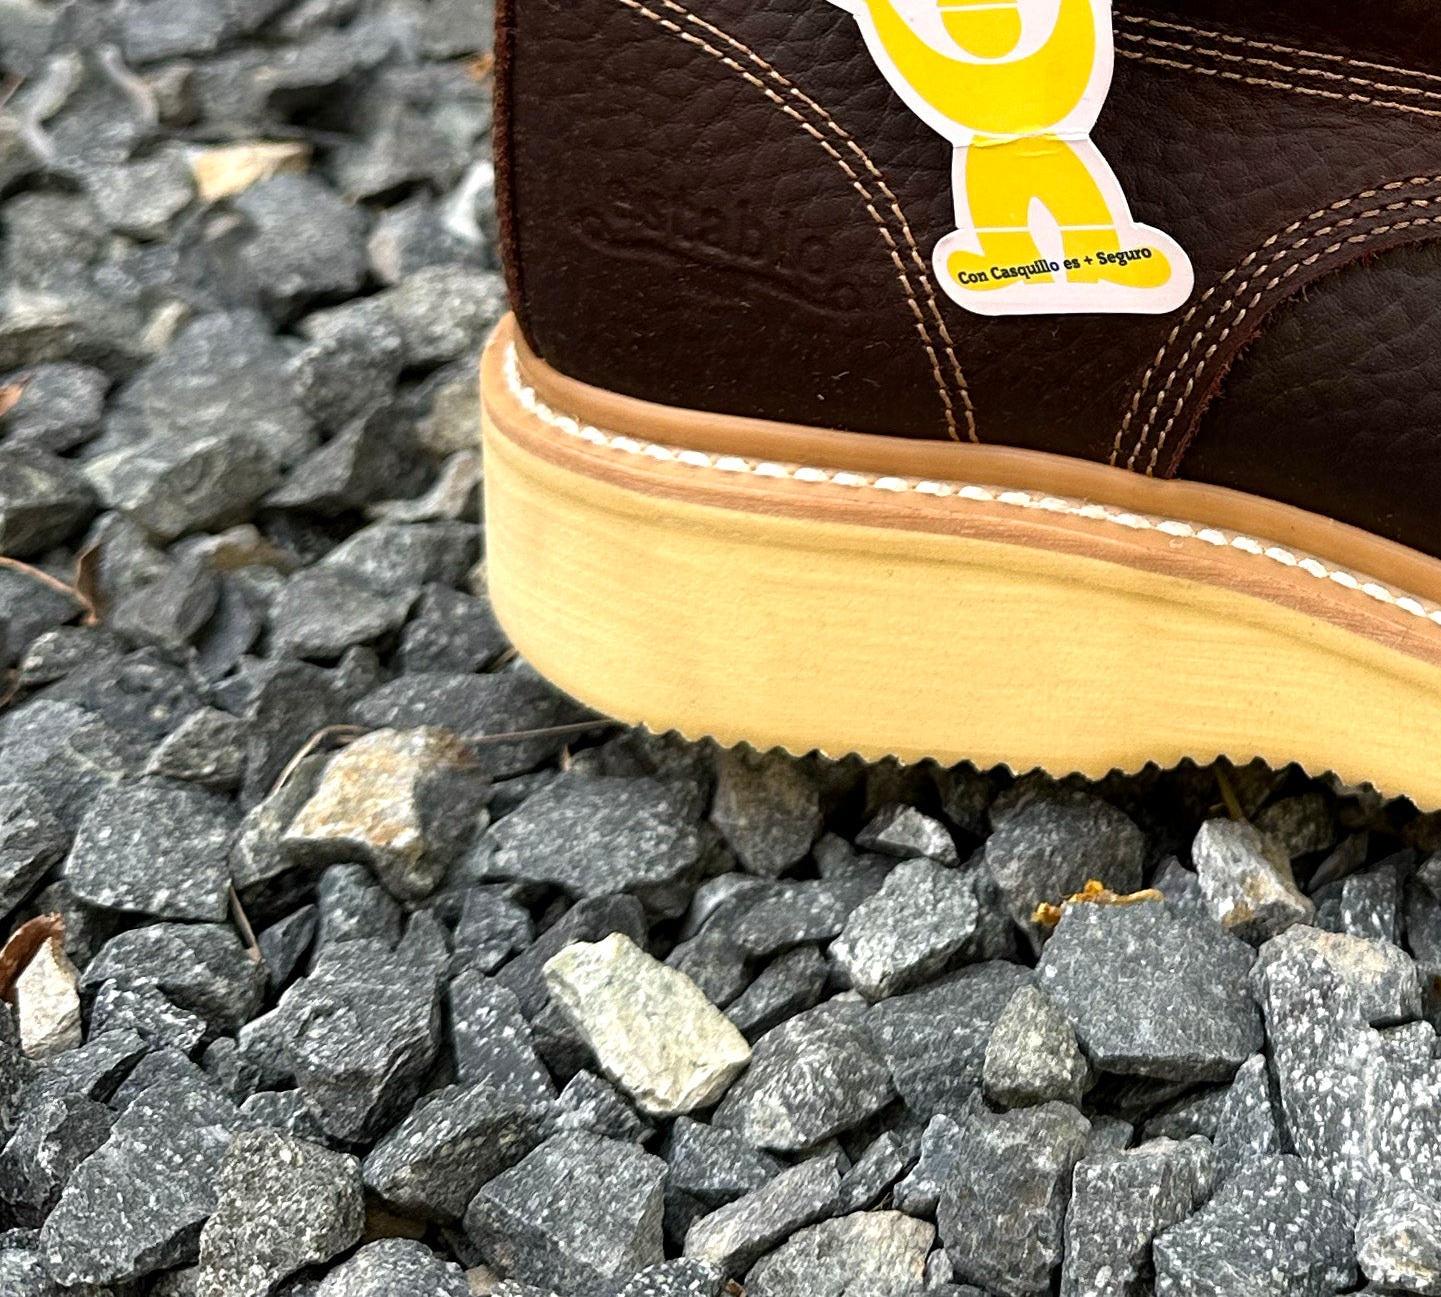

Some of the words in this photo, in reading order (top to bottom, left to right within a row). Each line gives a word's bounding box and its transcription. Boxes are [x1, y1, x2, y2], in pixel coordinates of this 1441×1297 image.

[958, 271, 989, 285] Con
[991, 260, 1060, 281] Casquillo
[1064, 257, 1081, 270] es
[1083, 255, 1094, 266] +
[1096, 246, 1152, 266] Seguro
